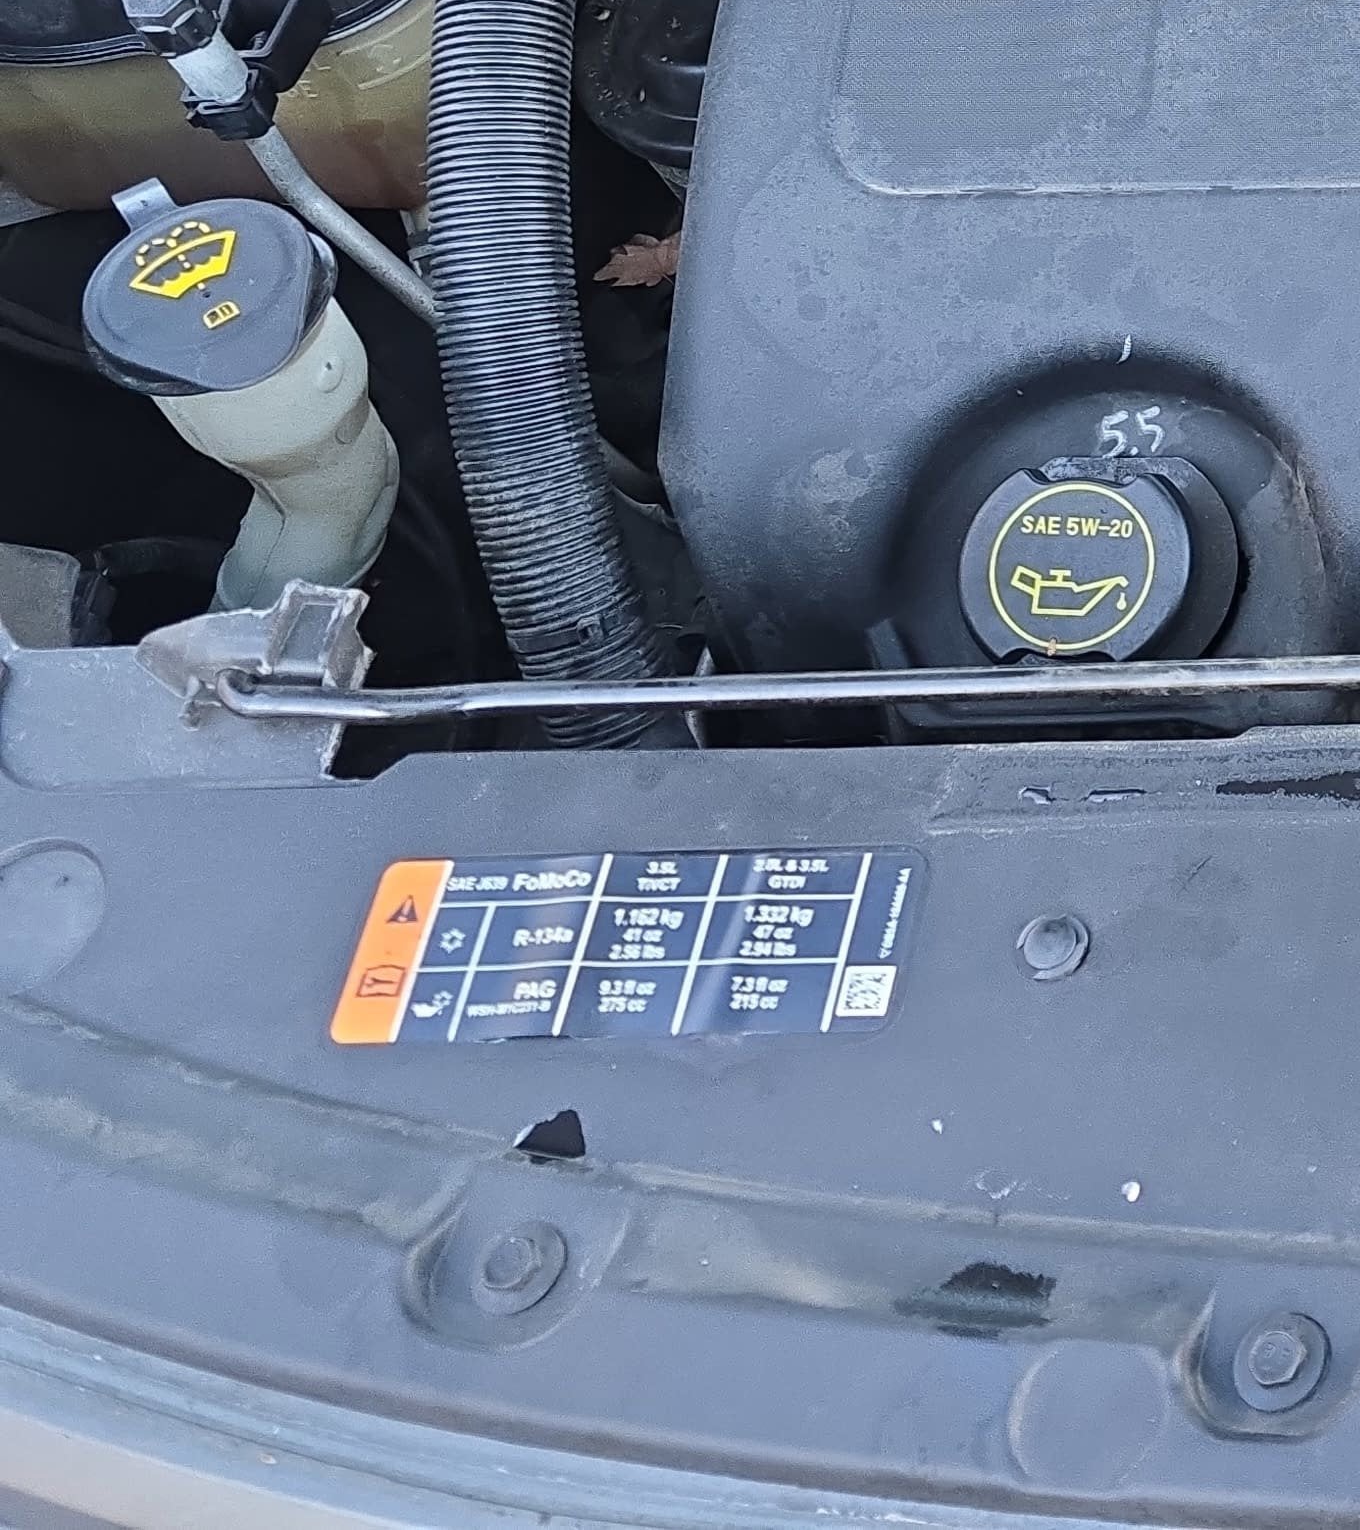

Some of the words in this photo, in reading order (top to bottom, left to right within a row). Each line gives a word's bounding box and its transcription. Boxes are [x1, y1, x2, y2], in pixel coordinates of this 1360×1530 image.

[1020, 515, 1060, 536] SAE
[1066, 517, 1133, 538] 5W-20
[447, 876, 478, 891] SAE
[513, 869, 592, 892] FoMoCo
[660, 908, 685, 930] kg
[789, 907, 814, 928] kg
[513, 927, 574, 947] R-134a
[643, 929, 664, 943] oz
[773, 925, 794, 940] oz
[514, 979, 557, 1000] PAG
[599, 980, 622, 996] 9.3
[731, 976, 755, 992] 7.3
[768, 977, 789, 992] oz
